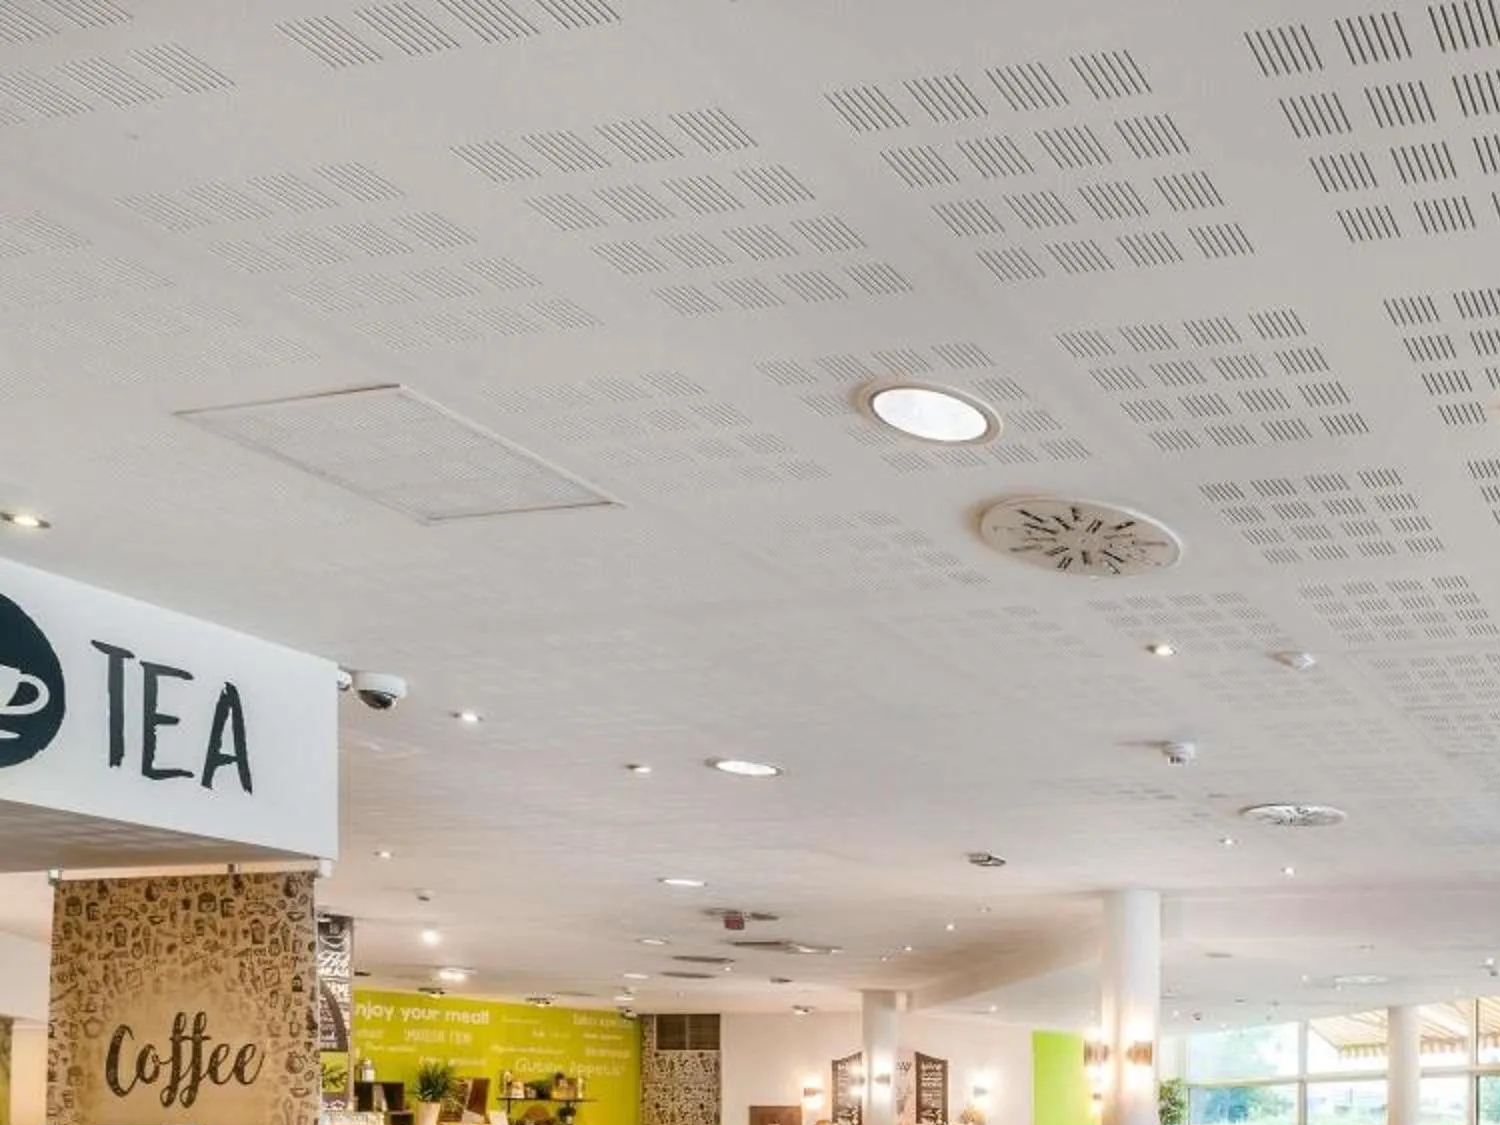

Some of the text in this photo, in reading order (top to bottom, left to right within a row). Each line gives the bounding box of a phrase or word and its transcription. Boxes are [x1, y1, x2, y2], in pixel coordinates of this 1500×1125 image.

[91, 639, 252, 795] TEA
[105, 1011, 266, 1108] Coffee
[400, 1006, 440, 1021] your
